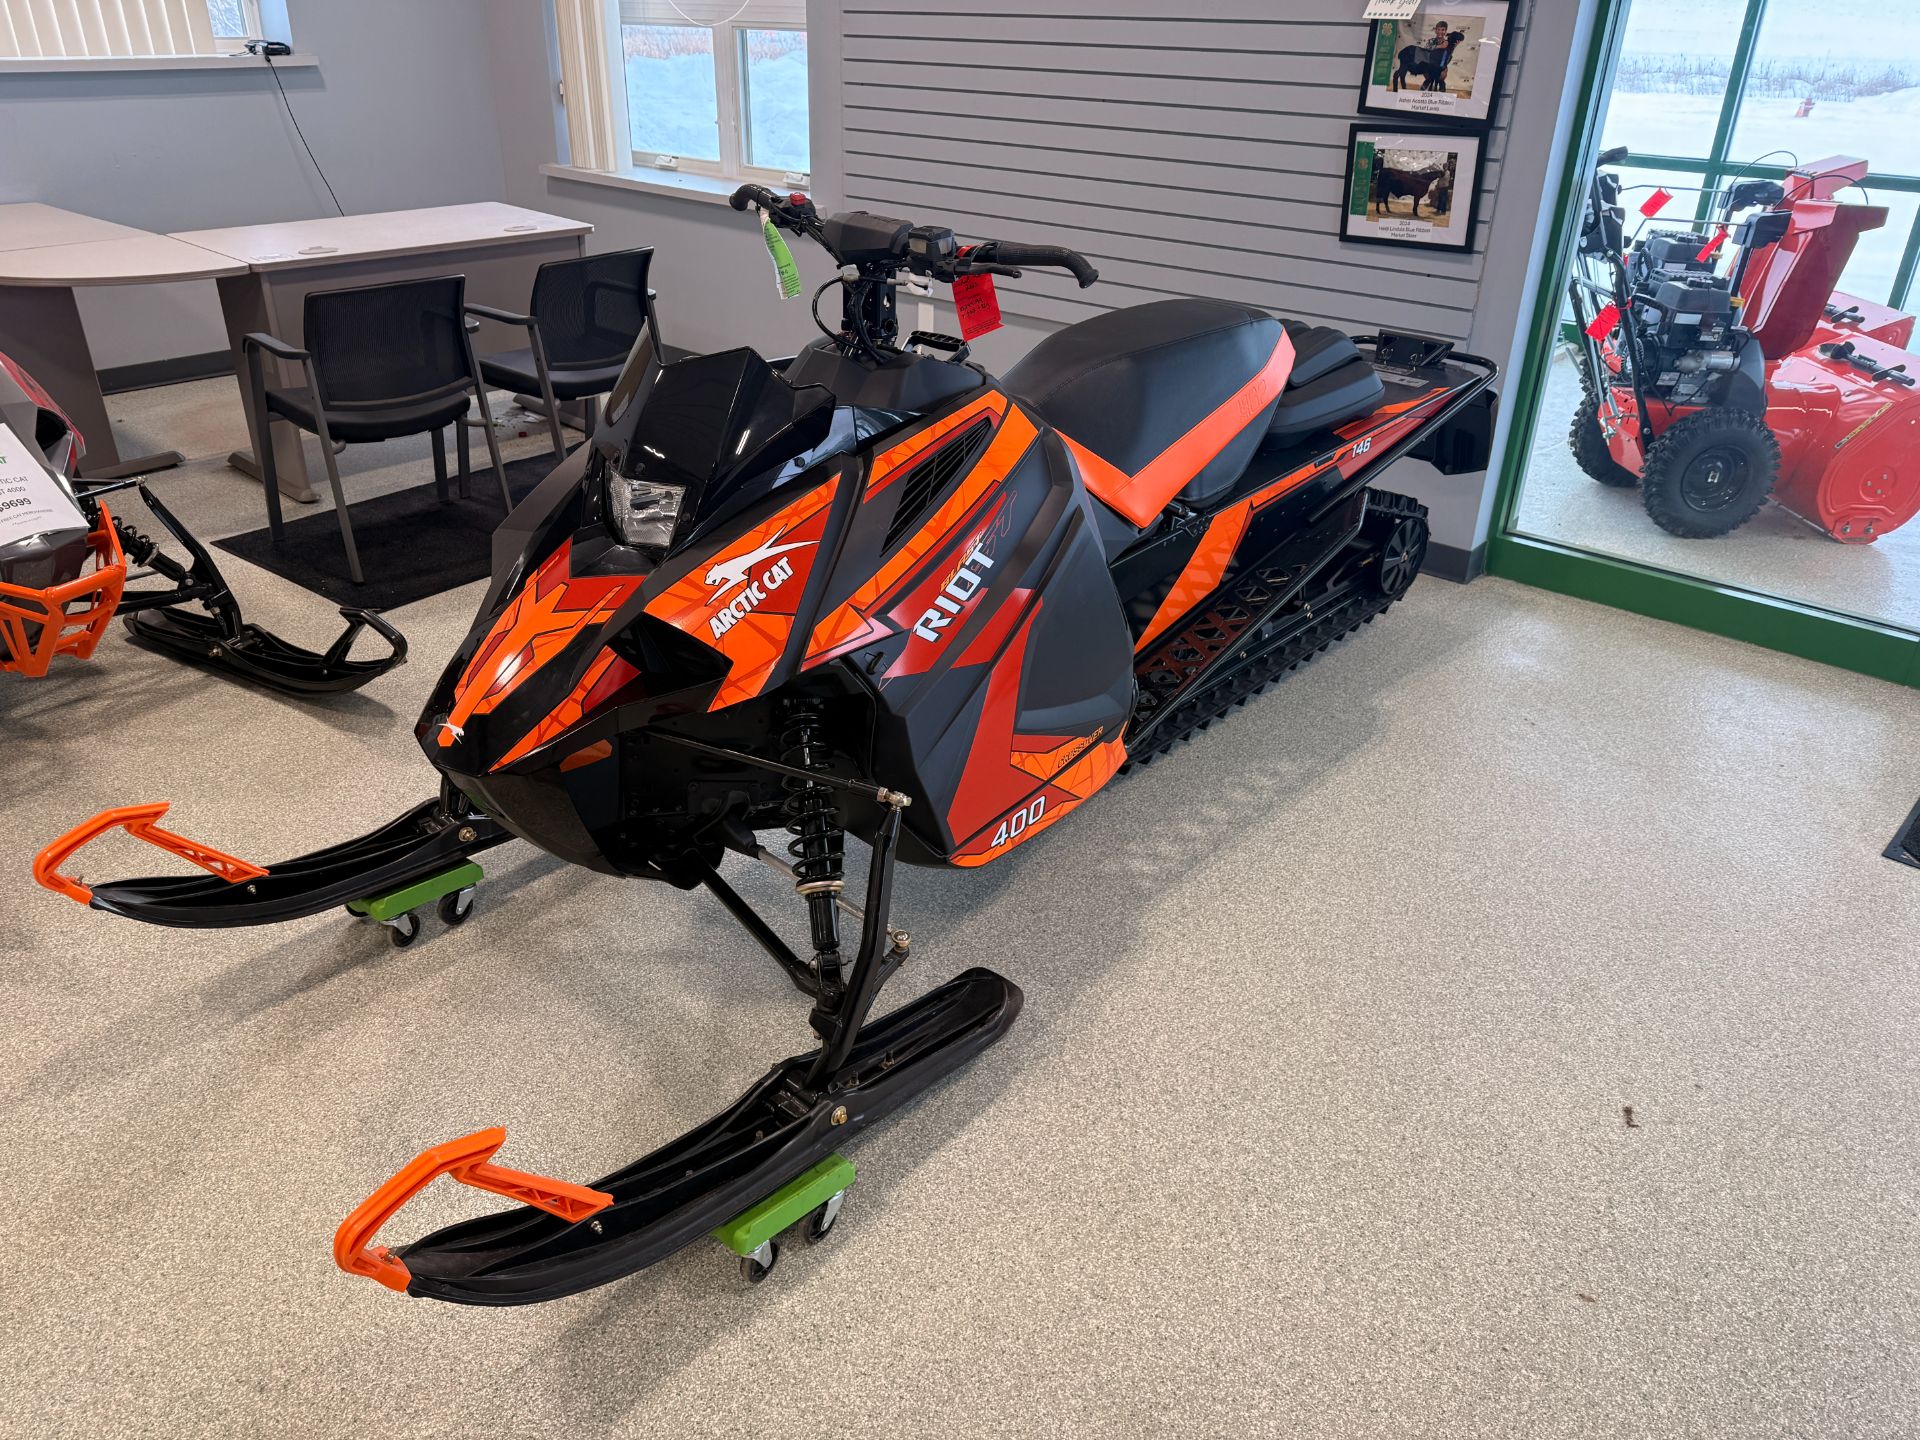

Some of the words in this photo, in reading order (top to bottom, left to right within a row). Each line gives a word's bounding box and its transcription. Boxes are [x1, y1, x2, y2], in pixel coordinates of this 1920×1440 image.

[1352, 437, 1372, 458] 146
[708, 580, 767, 640] ARCTIC
[762, 556, 794, 590] CAT
[913, 542, 994, 643] RIOT
[990, 796, 1046, 848] 400
